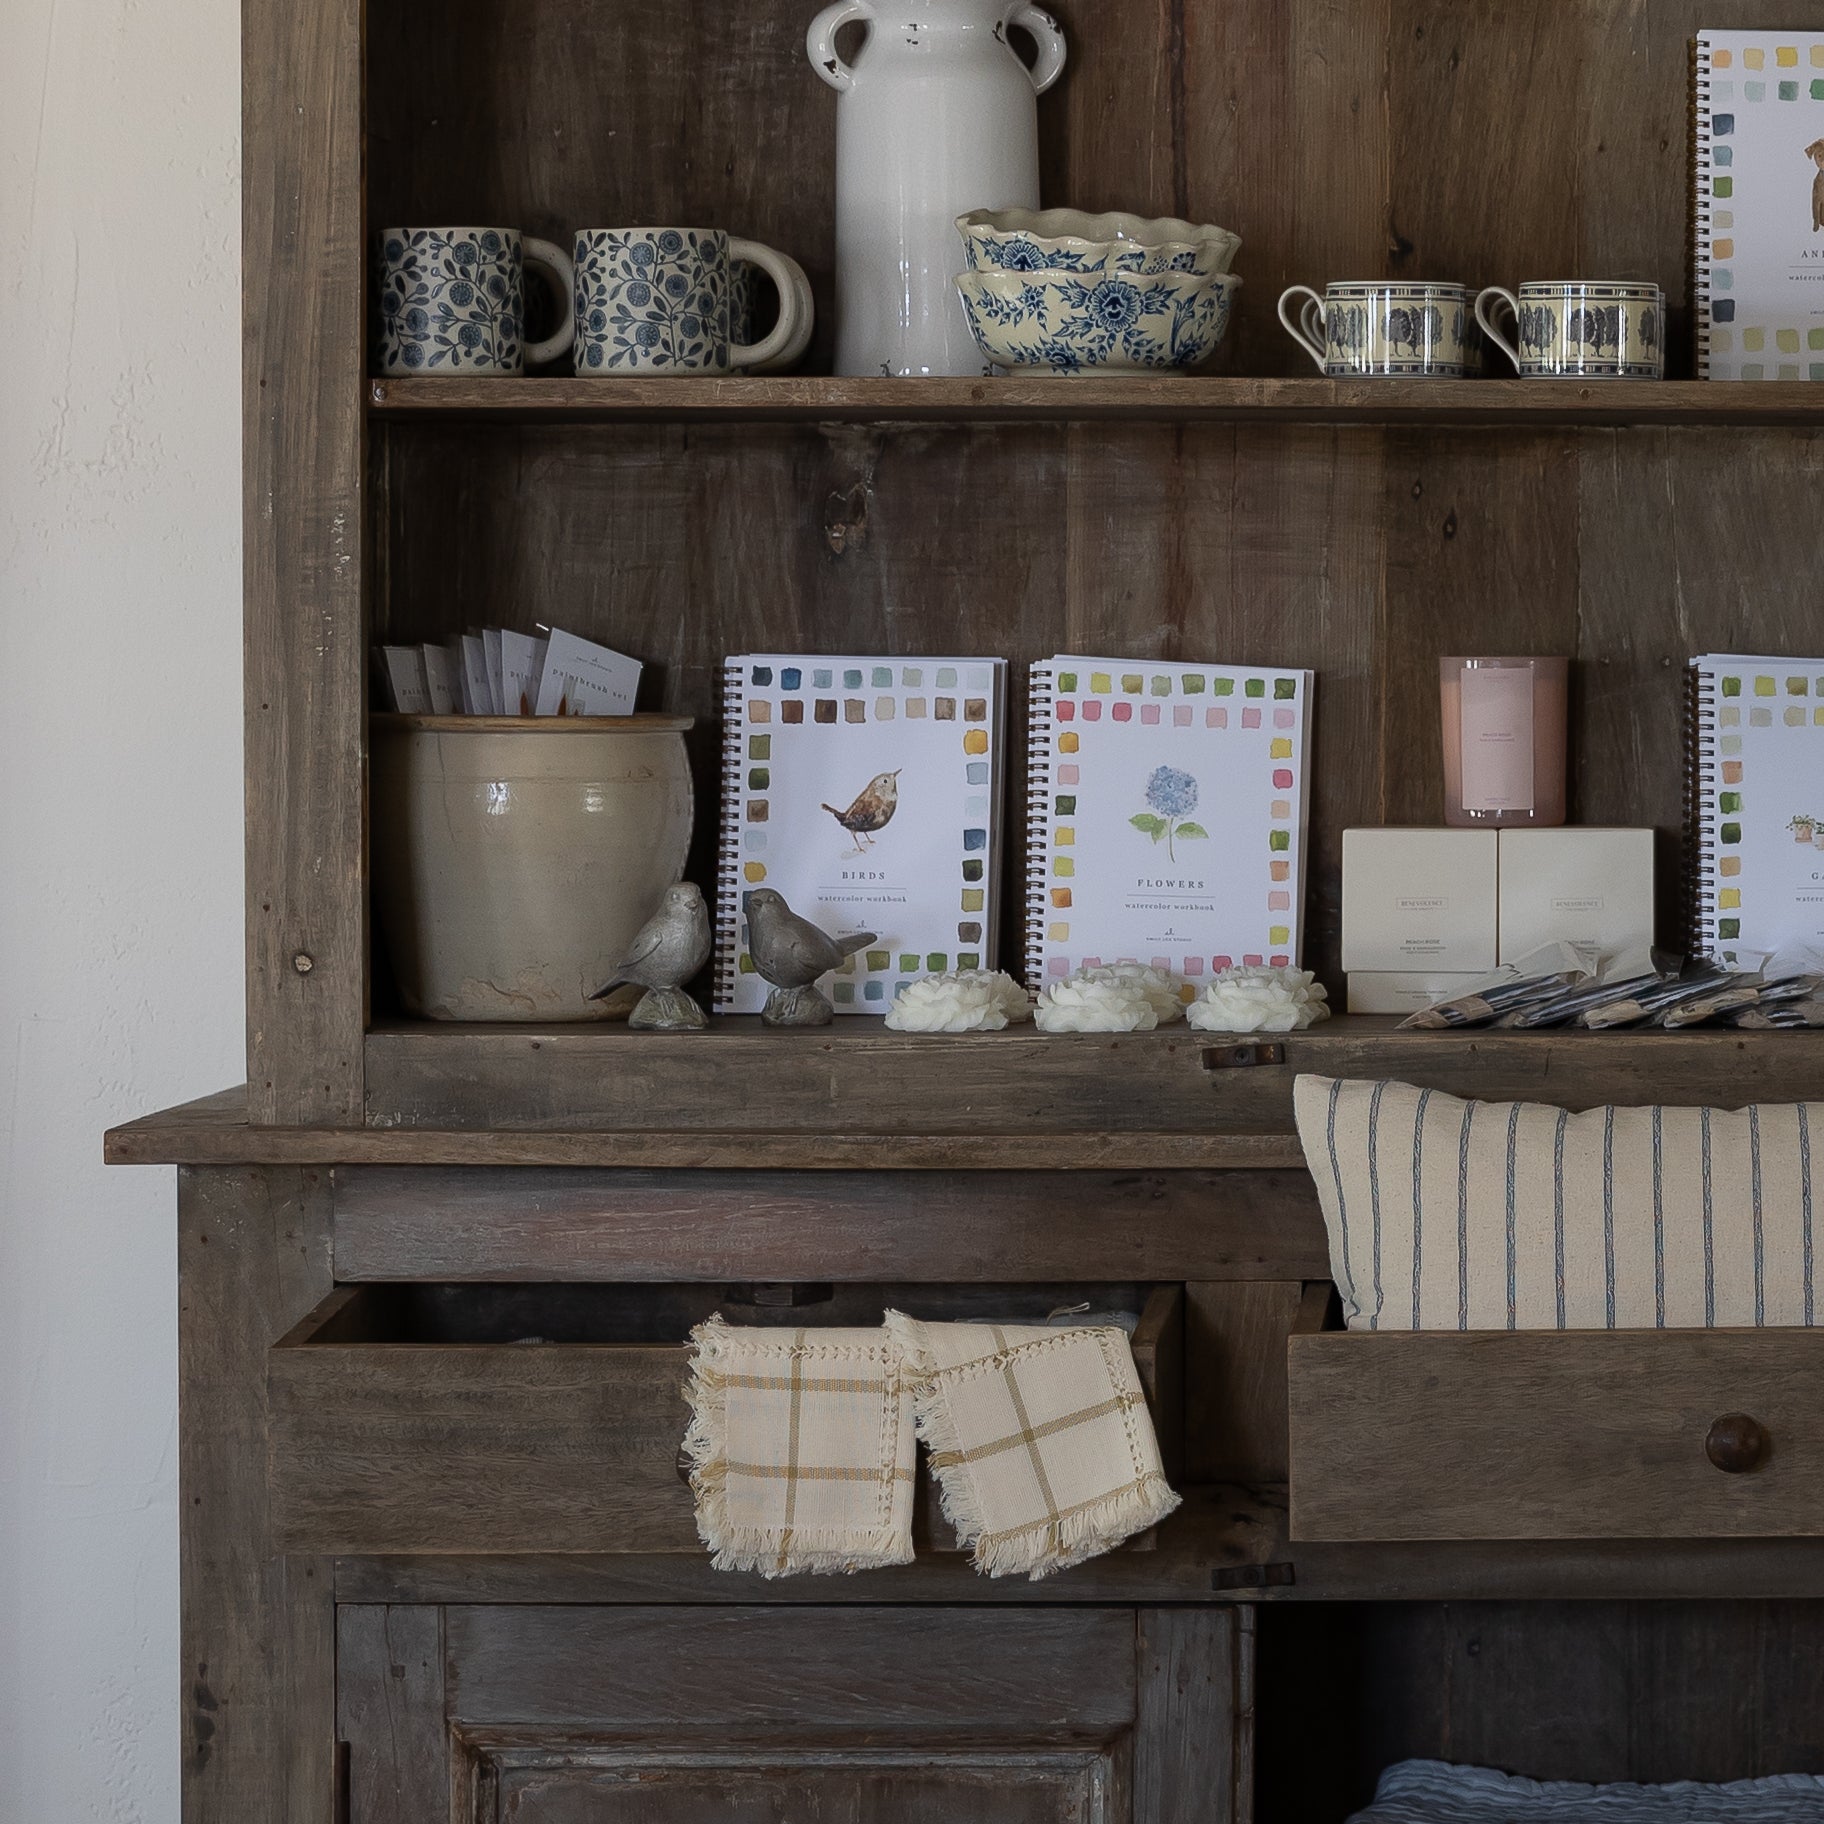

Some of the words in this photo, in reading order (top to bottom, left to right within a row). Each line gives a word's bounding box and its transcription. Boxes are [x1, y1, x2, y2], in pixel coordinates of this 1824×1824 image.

[552, 668, 608, 694] paintbrush
[842, 871, 885, 880] BIRDS
[1137, 879, 1204, 889] FLOWERS
[866, 895, 907, 903] workbook
